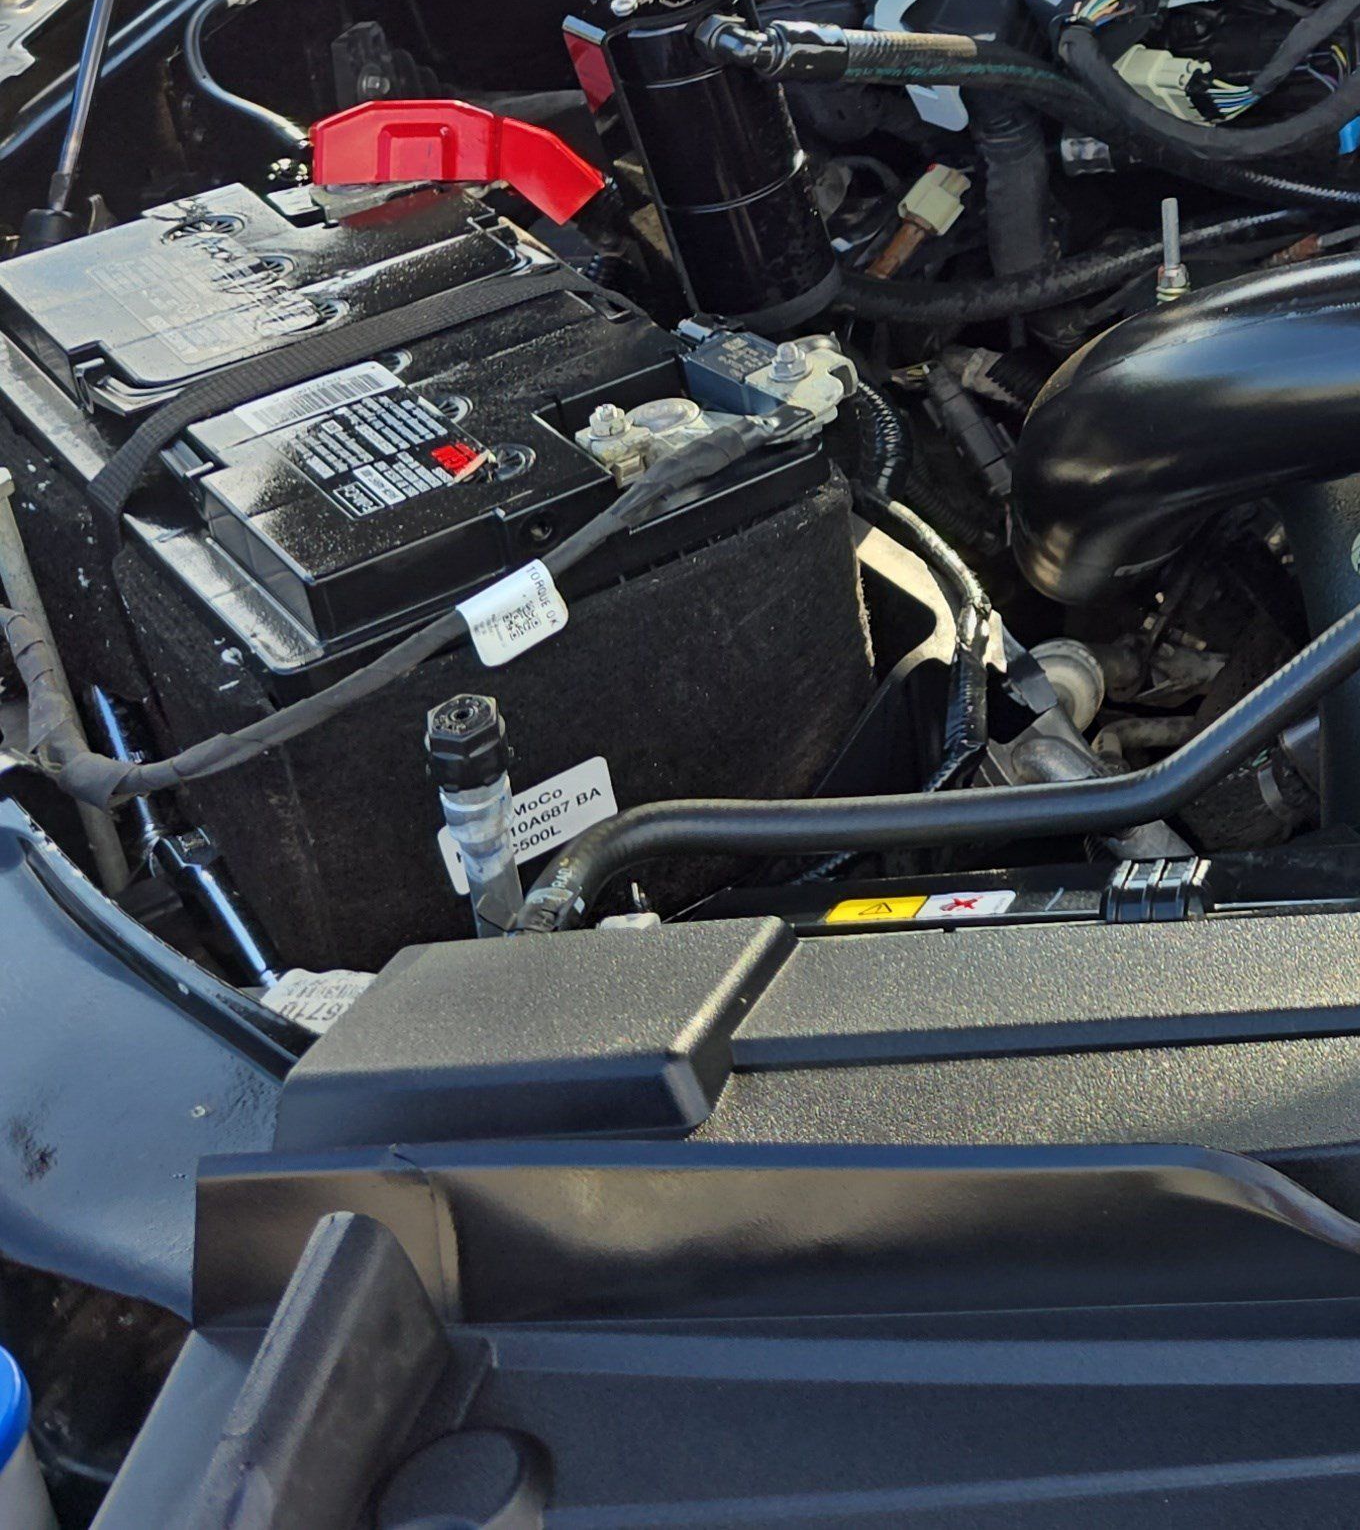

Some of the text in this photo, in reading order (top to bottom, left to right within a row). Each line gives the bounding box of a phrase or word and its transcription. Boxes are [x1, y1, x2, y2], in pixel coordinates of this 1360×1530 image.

[525, 566, 559, 627] TORQUE OK
[511, 787, 563, 818] MoCo
[576, 787, 602, 806] BA
